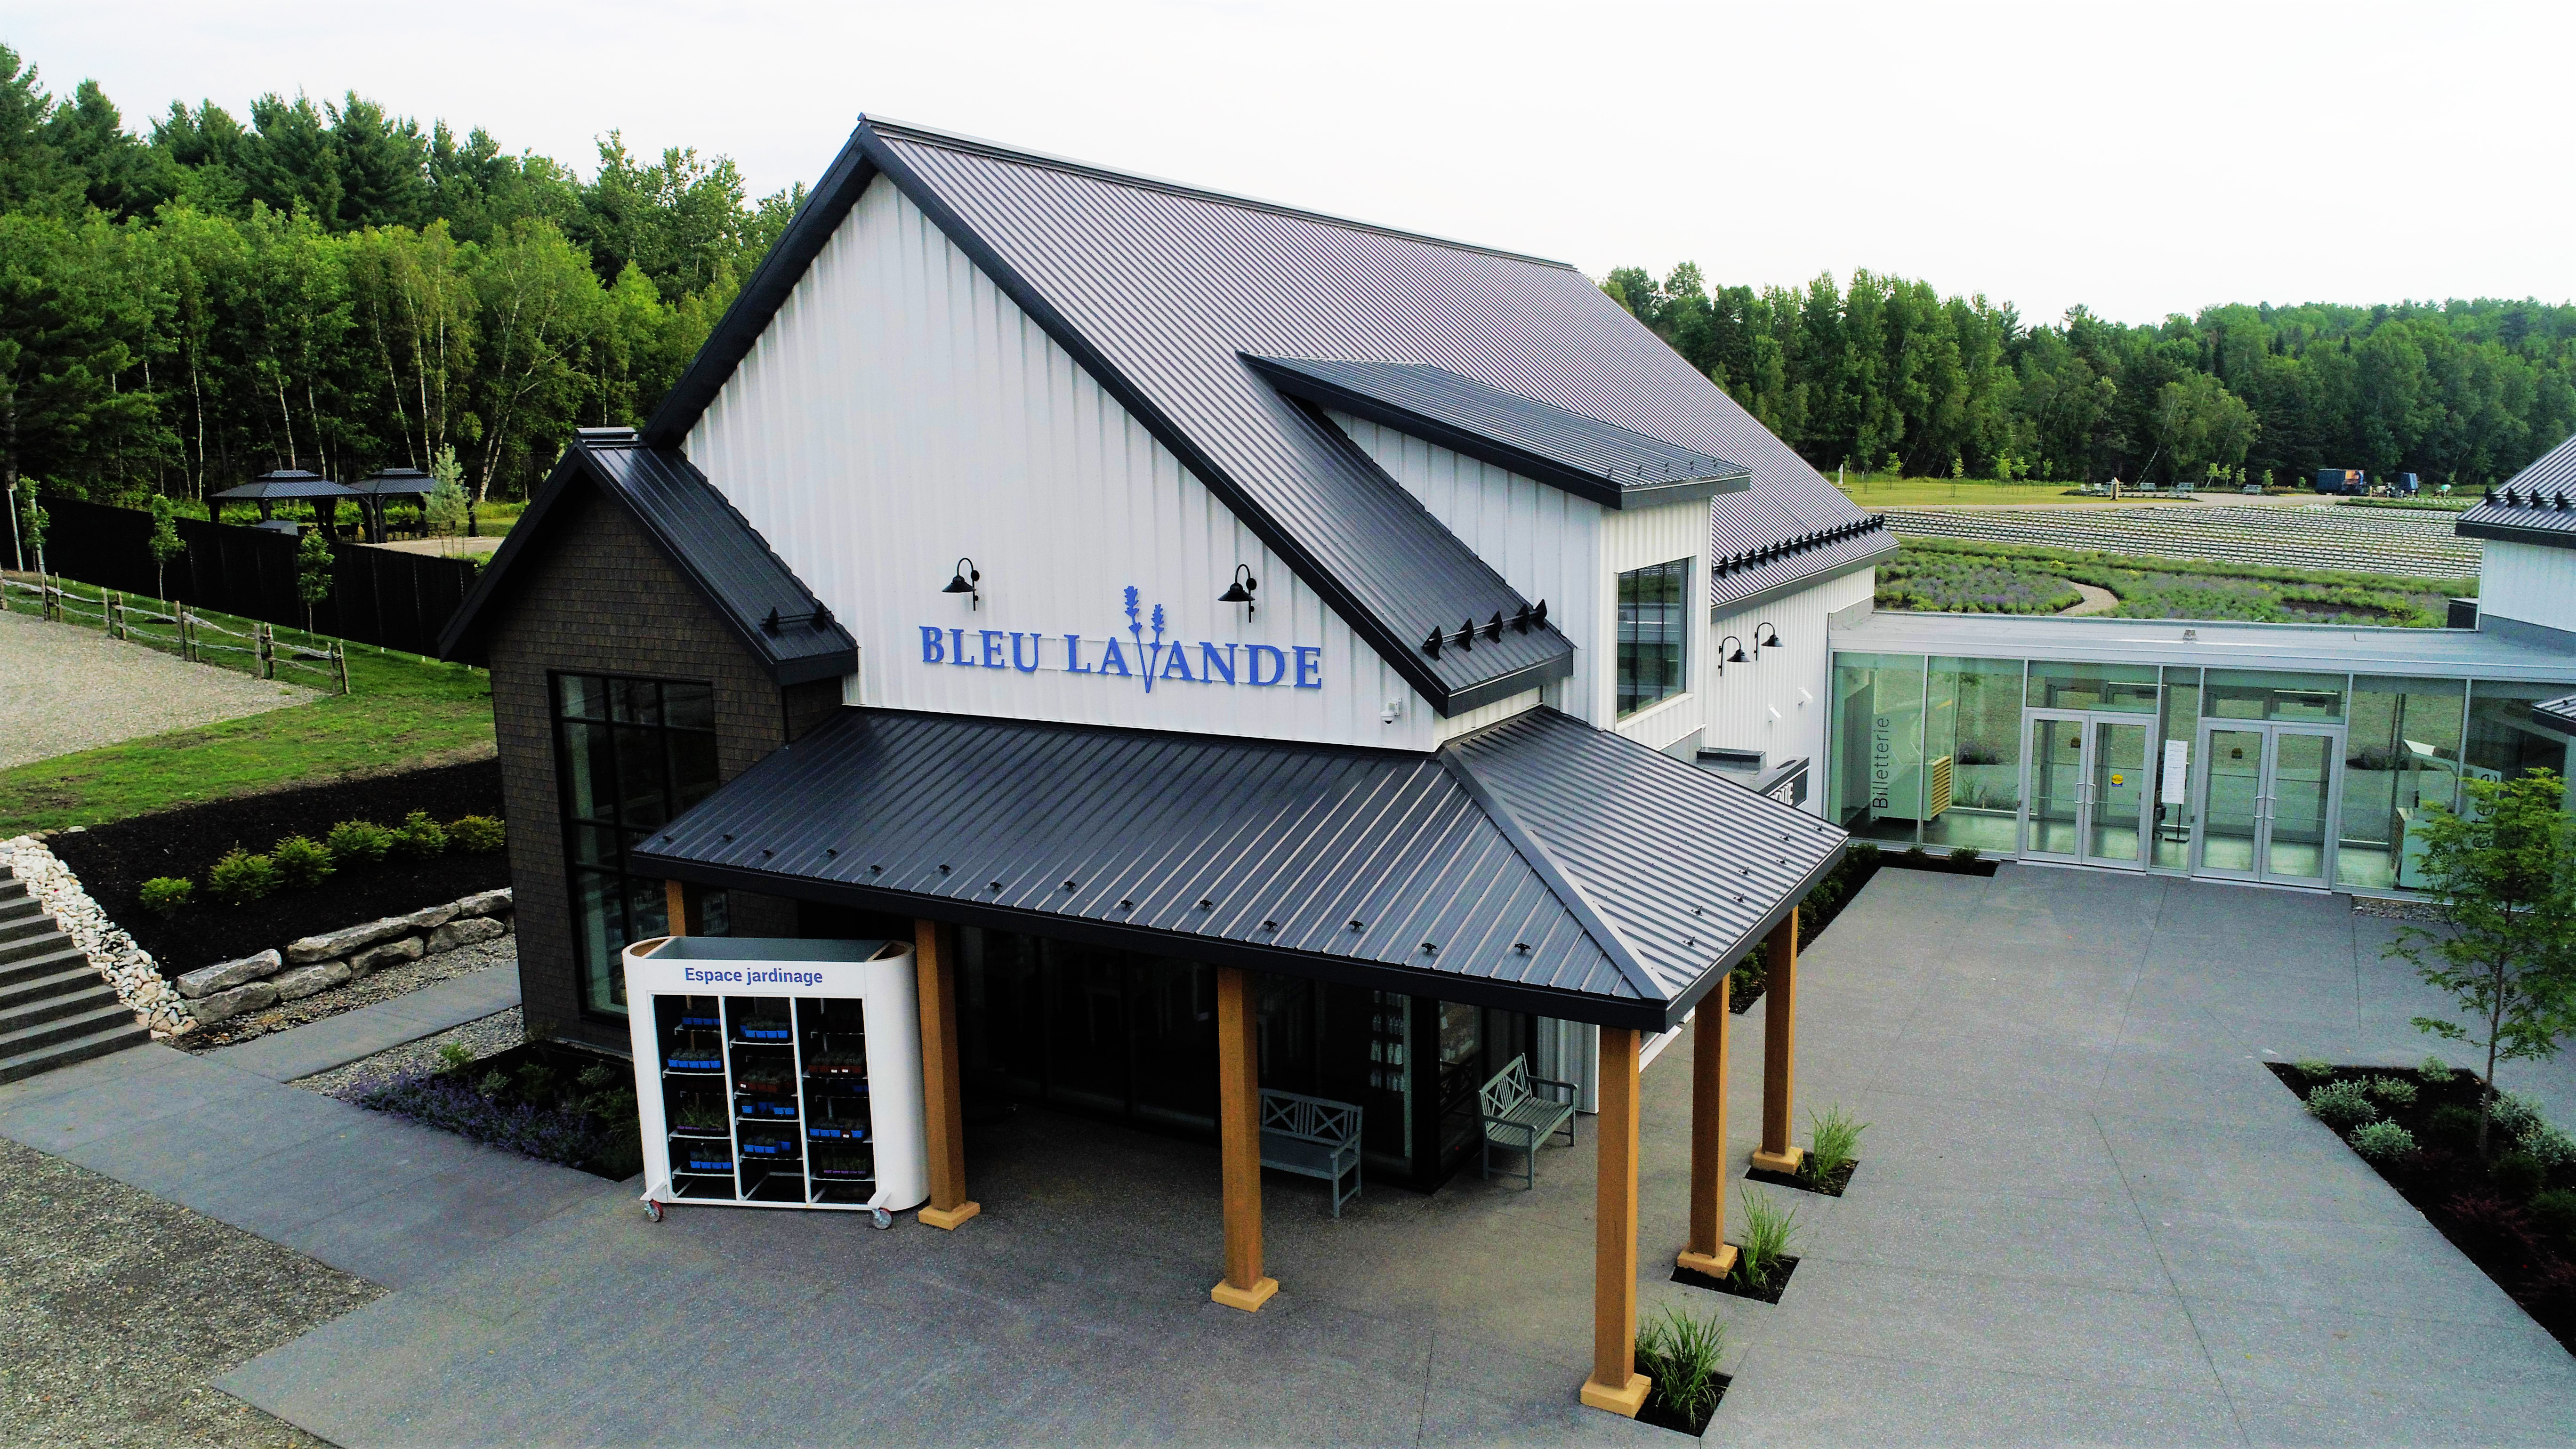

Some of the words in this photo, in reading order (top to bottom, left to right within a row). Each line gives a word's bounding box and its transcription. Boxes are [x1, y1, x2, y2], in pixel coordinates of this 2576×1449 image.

[919, 626, 1041, 673] BLEU
[1064, 624, 1321, 693] LAVANDE
[1872, 718, 1889, 808] Billetterie
[685, 967, 742, 984] Espace
[746, 968, 822, 986] jardinage
